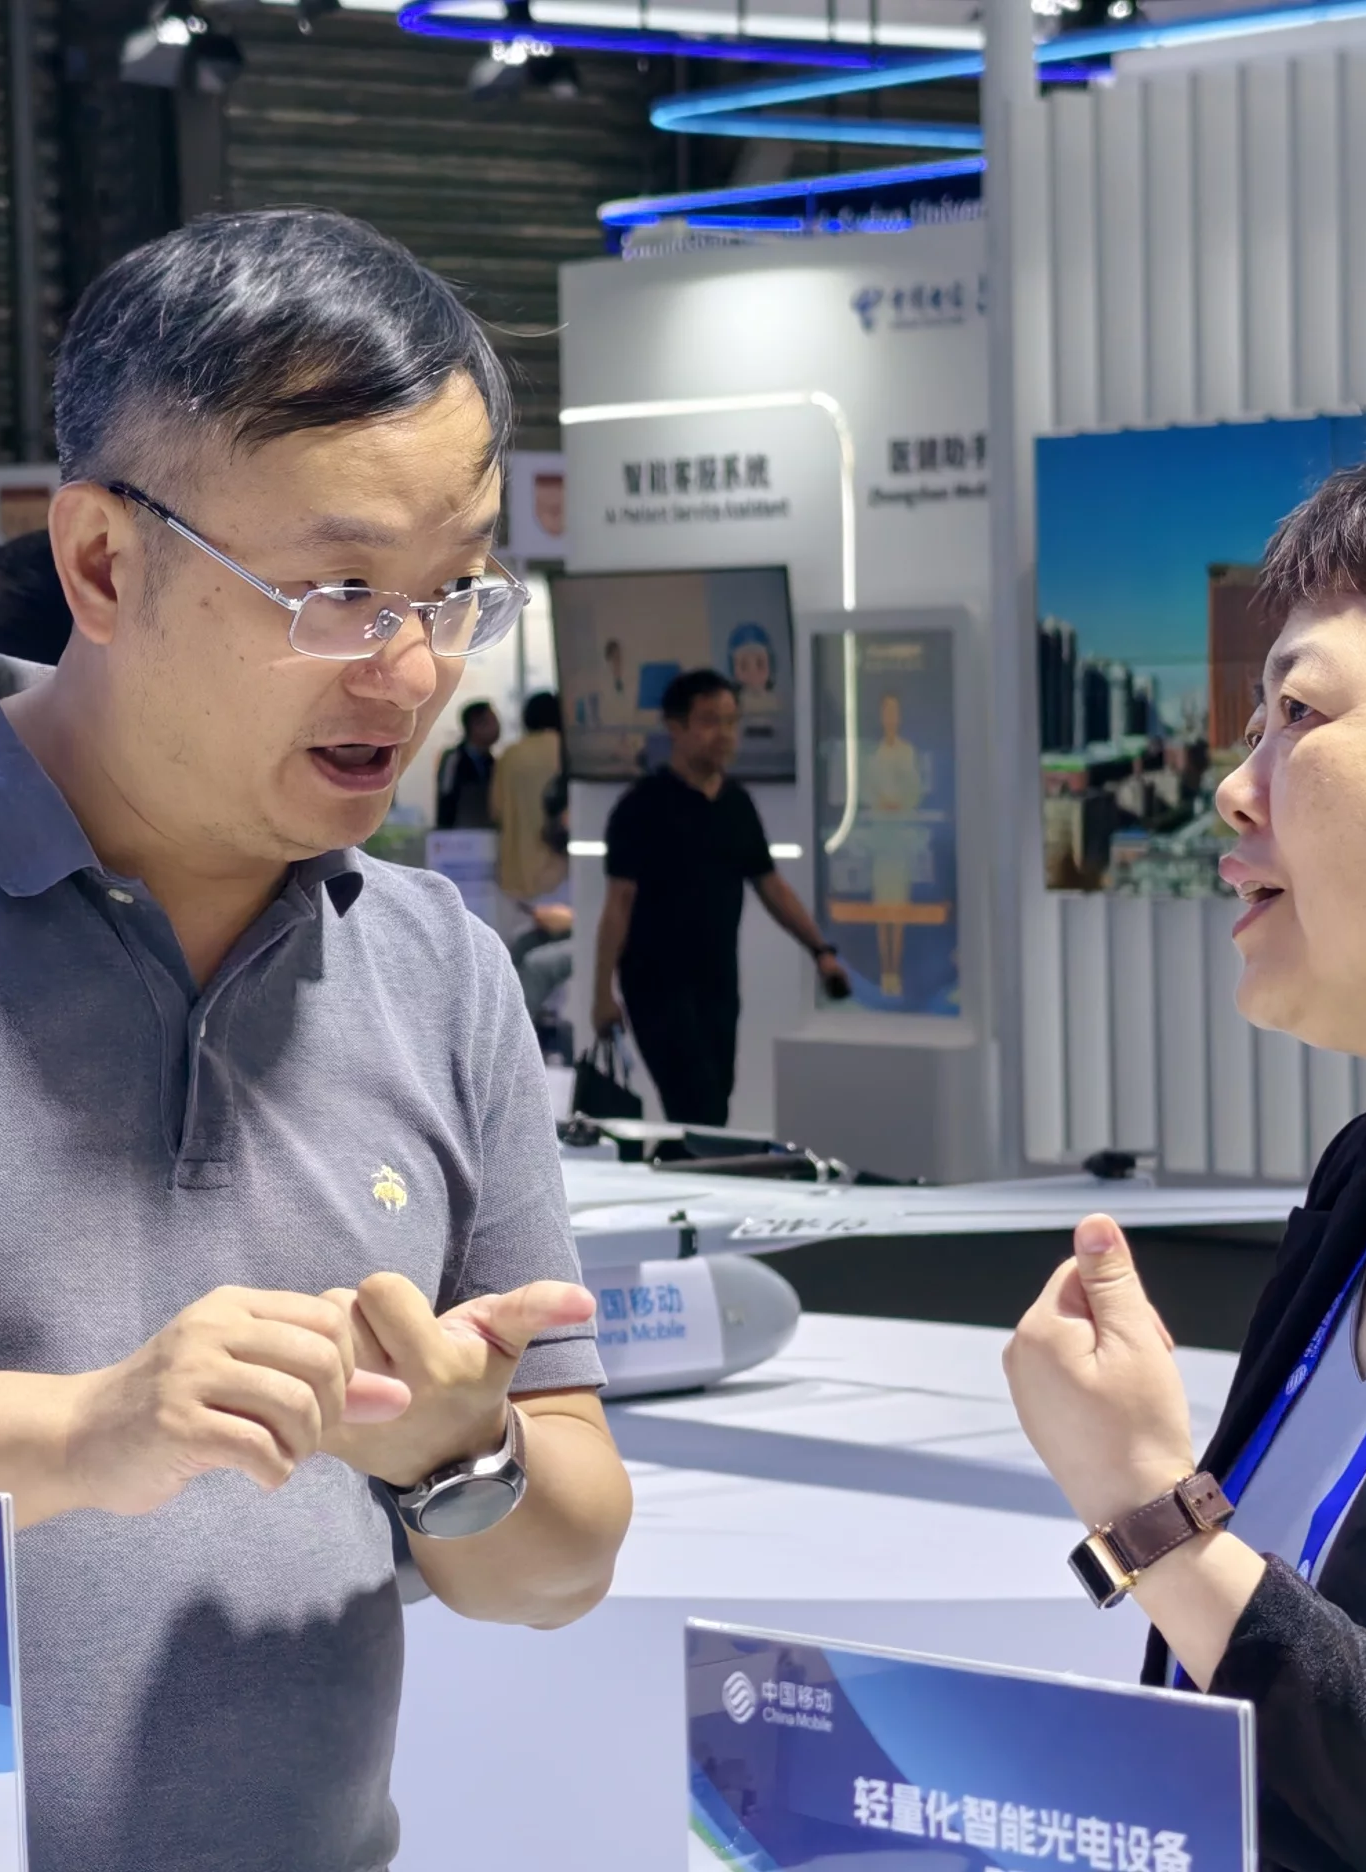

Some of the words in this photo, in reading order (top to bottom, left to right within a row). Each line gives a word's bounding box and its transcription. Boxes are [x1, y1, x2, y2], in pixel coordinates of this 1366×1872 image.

[762, 1680, 832, 1714] 中国移动
[853, 1776, 1192, 1872] 轻量化智能光电设备
